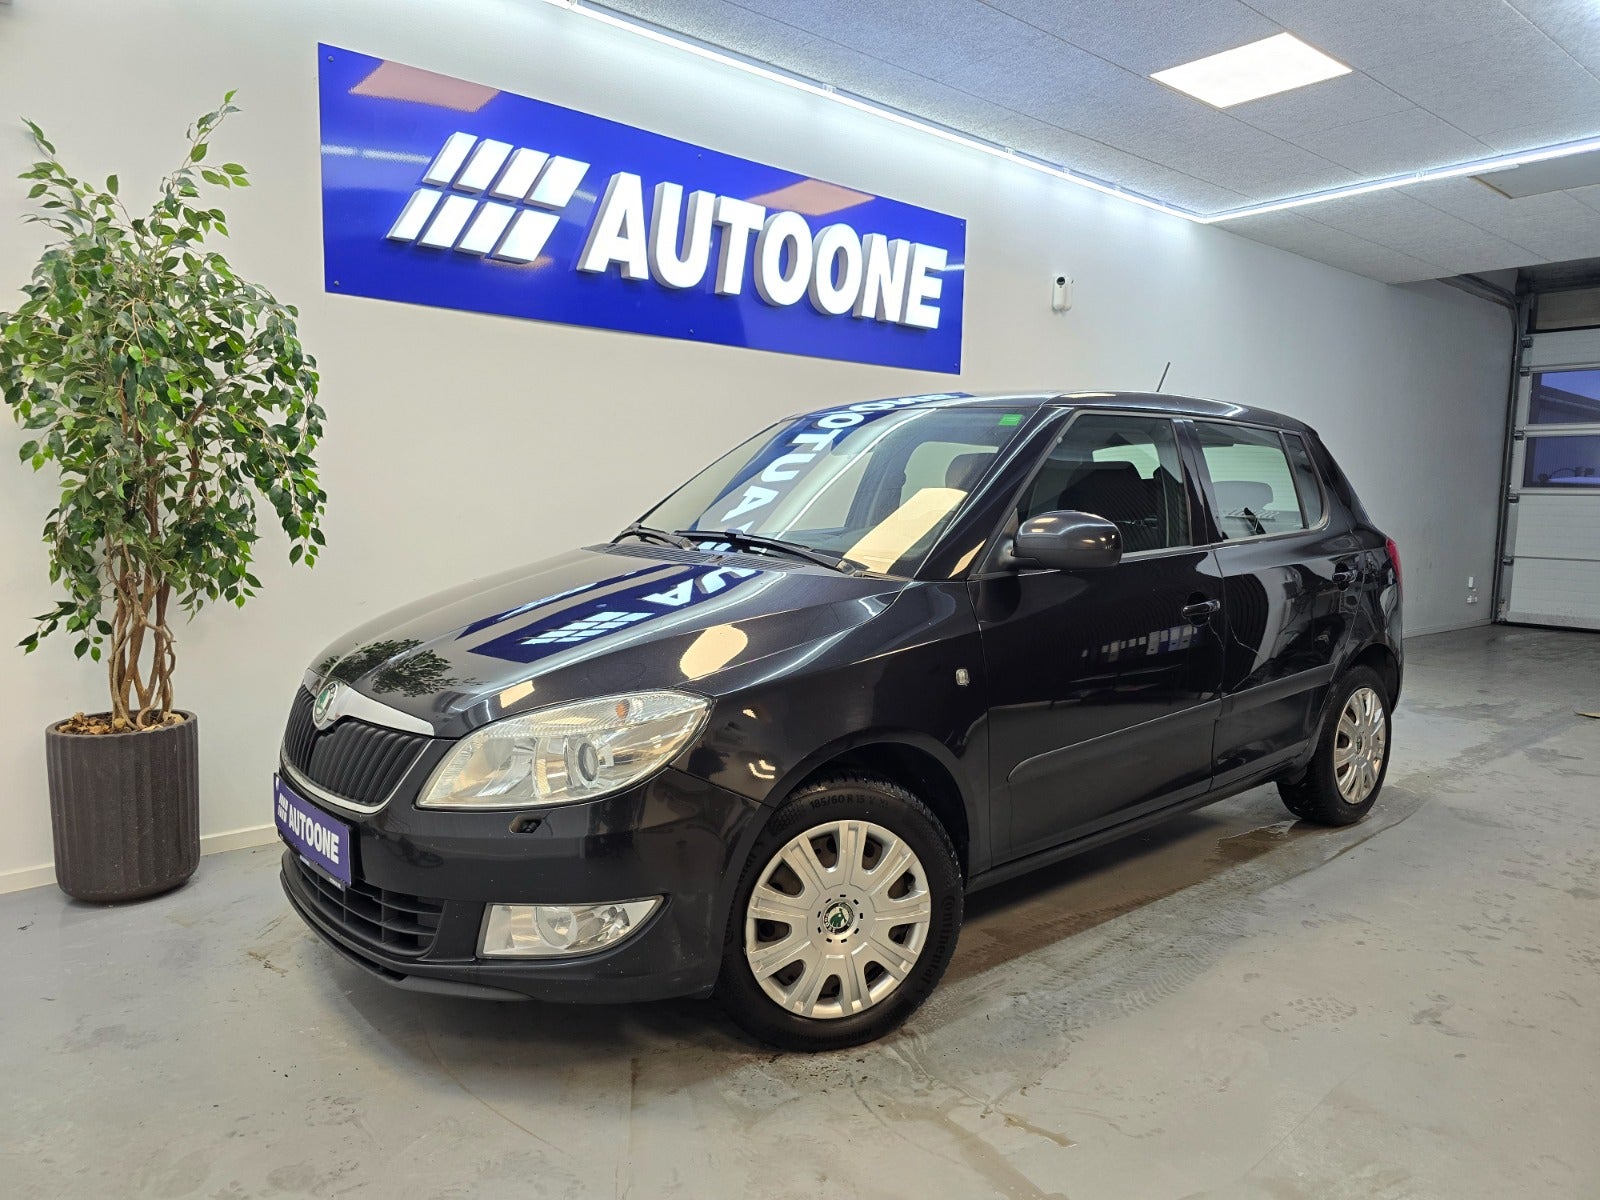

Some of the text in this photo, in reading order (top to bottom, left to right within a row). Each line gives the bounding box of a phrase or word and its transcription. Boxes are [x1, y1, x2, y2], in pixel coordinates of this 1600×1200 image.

[576, 171, 947, 330] AUTOONE
[288, 803, 340, 865] AUTOONE
[809, 794, 845, 809] 185/60
[921, 895, 955, 985] Continental
